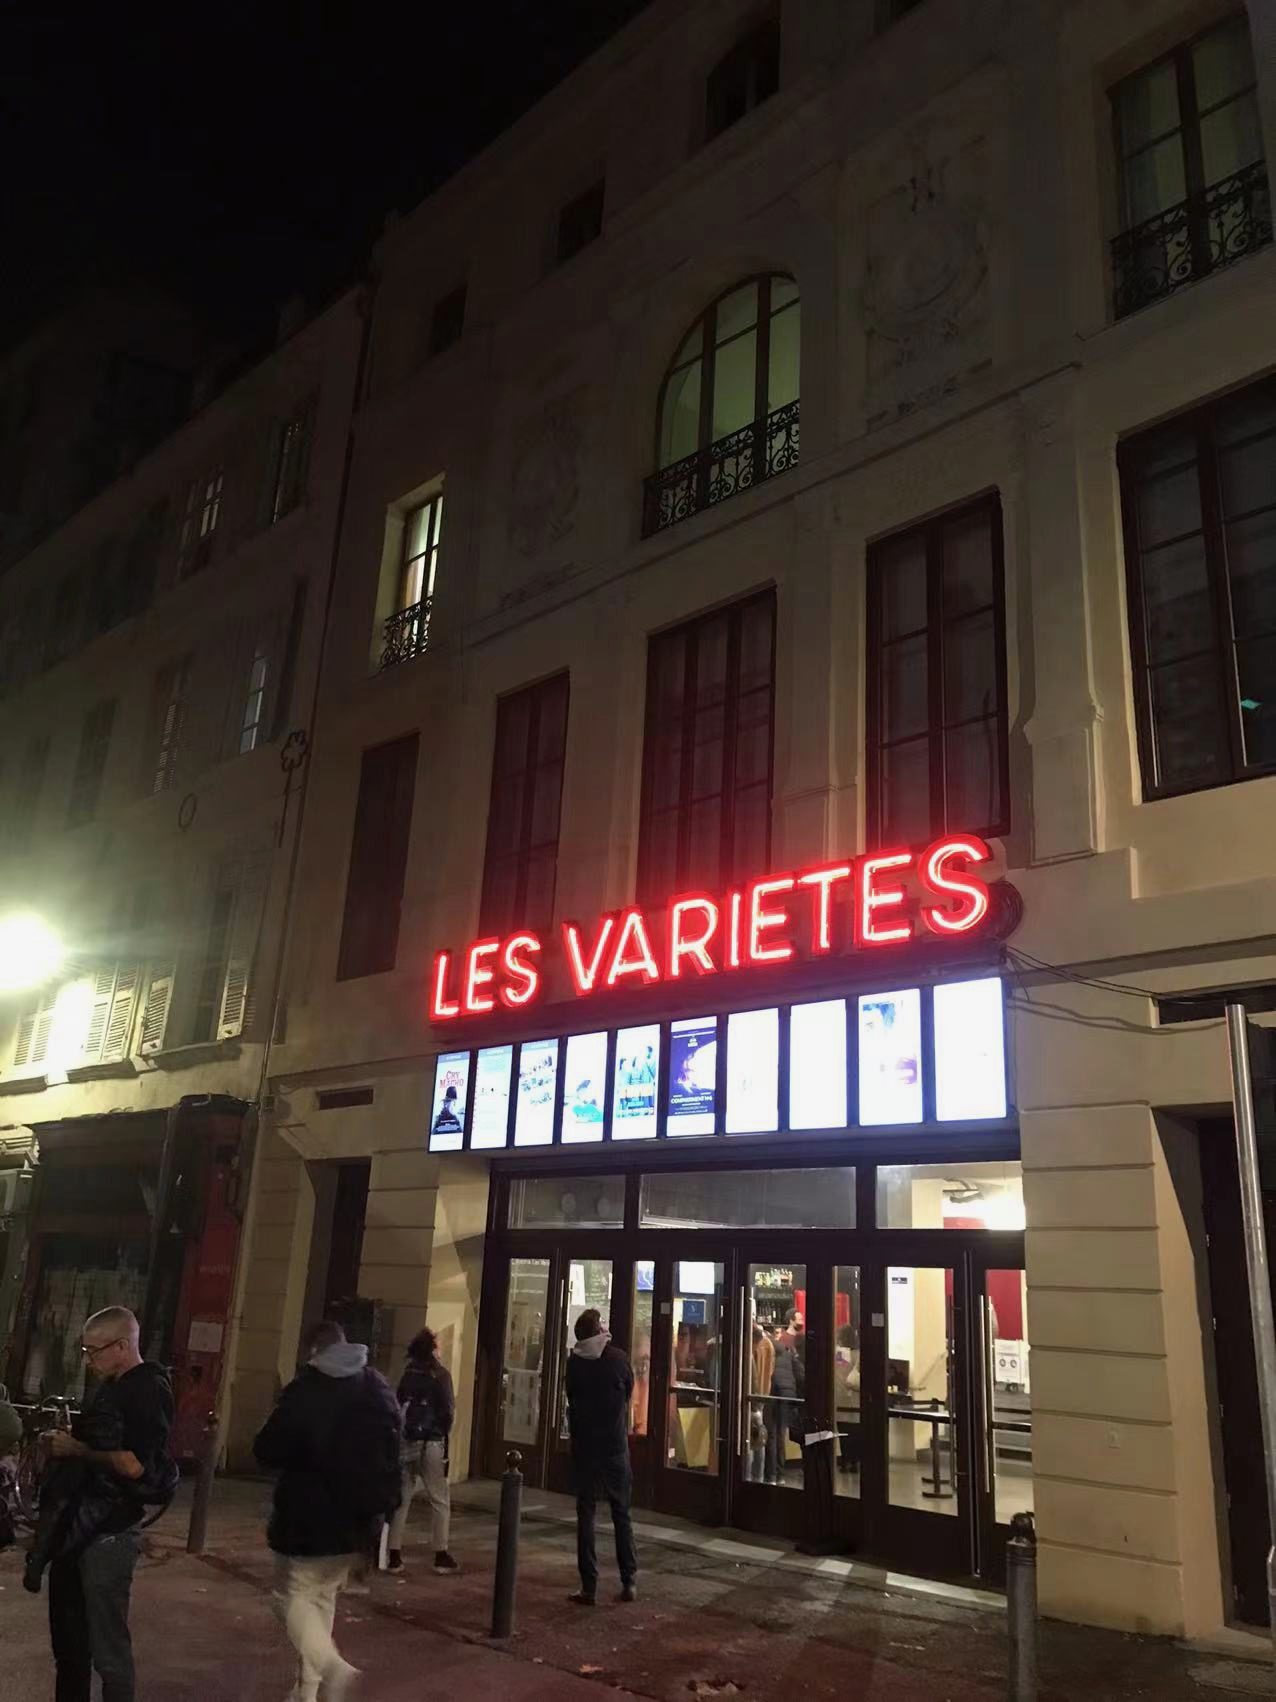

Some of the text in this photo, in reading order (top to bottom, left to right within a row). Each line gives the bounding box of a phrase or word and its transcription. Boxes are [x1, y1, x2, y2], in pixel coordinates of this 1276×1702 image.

[431, 835, 993, 1020] LES VARIETES
[446, 1071, 460, 1079] CRY
[440, 1079, 464, 1088] MACHO
